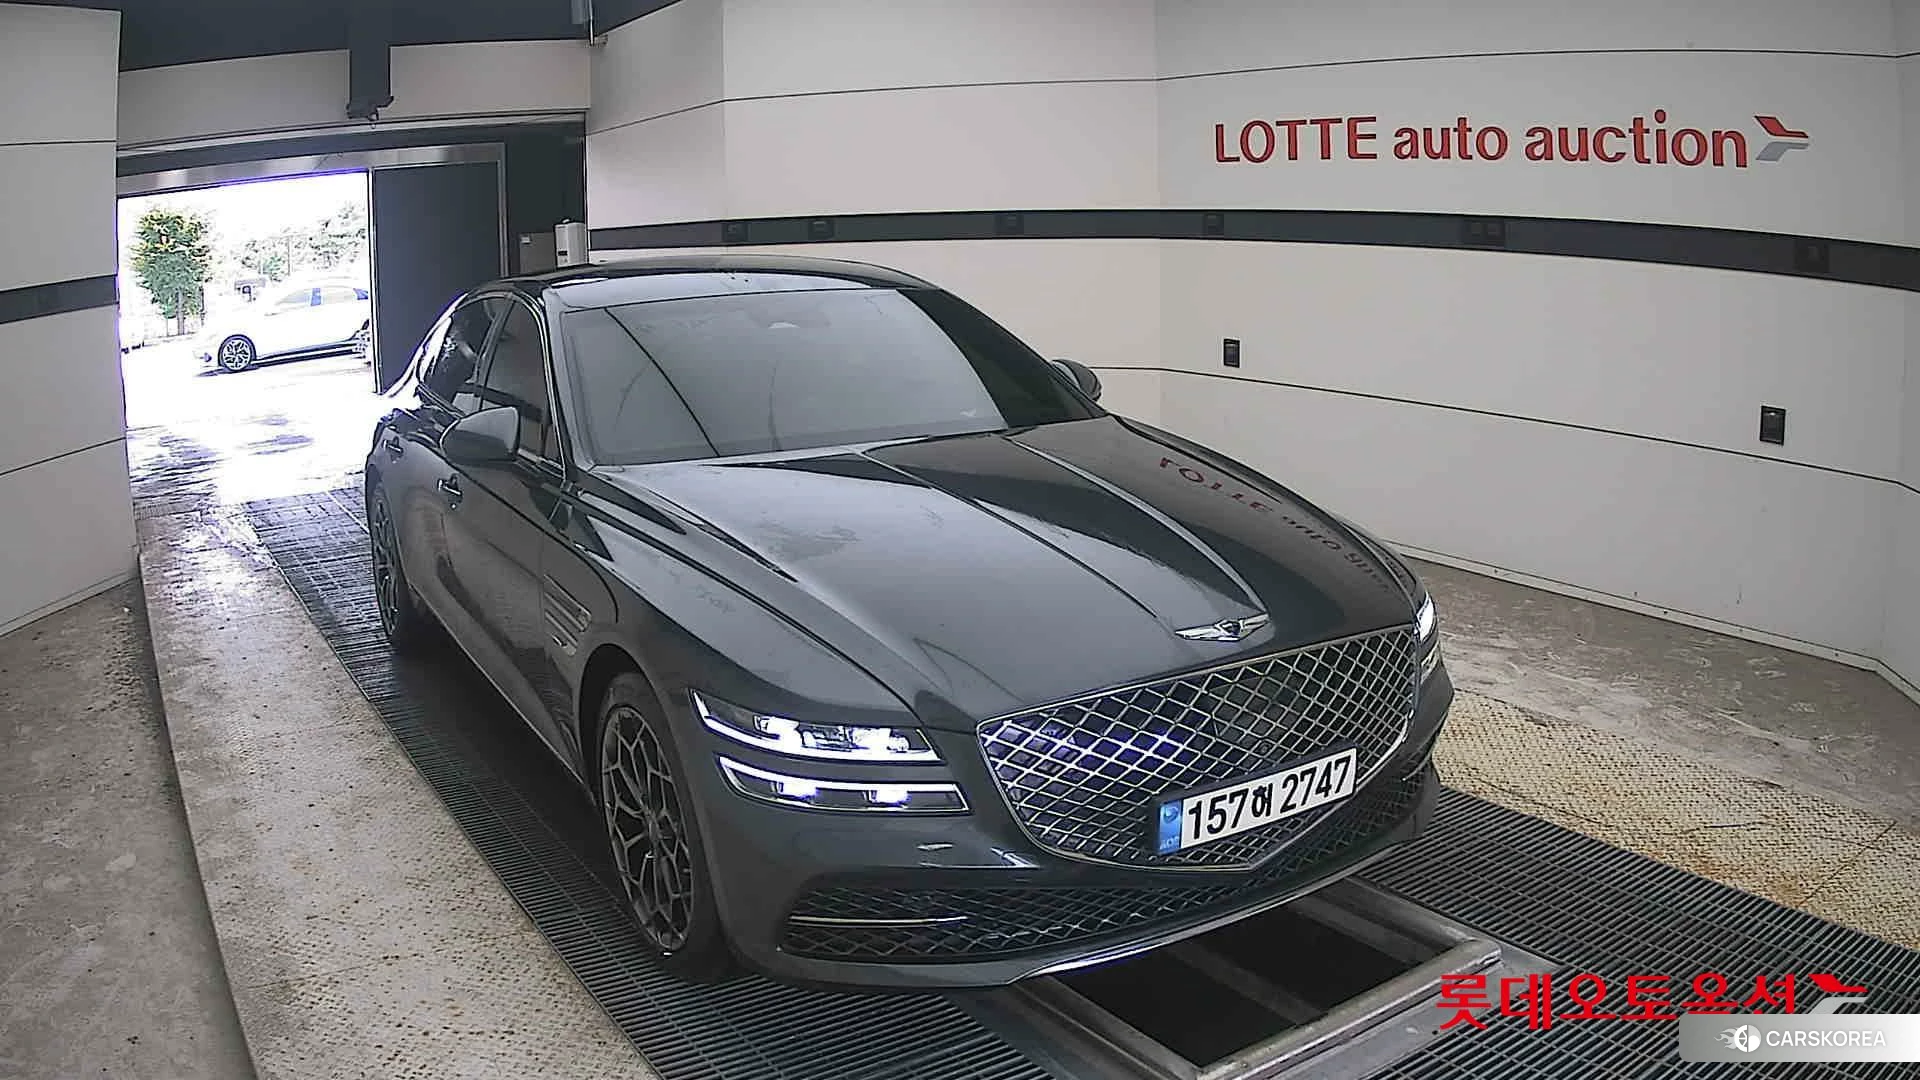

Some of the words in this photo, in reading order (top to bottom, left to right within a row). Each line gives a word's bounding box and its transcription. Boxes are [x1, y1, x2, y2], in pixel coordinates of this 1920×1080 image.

[1215, 116, 1378, 163] LOTTE
[1393, 116, 1508, 161] auto
[1524, 108, 1748, 168] auction
[1188, 782, 1274, 840] 157허
[1280, 754, 1351, 814] 2747
